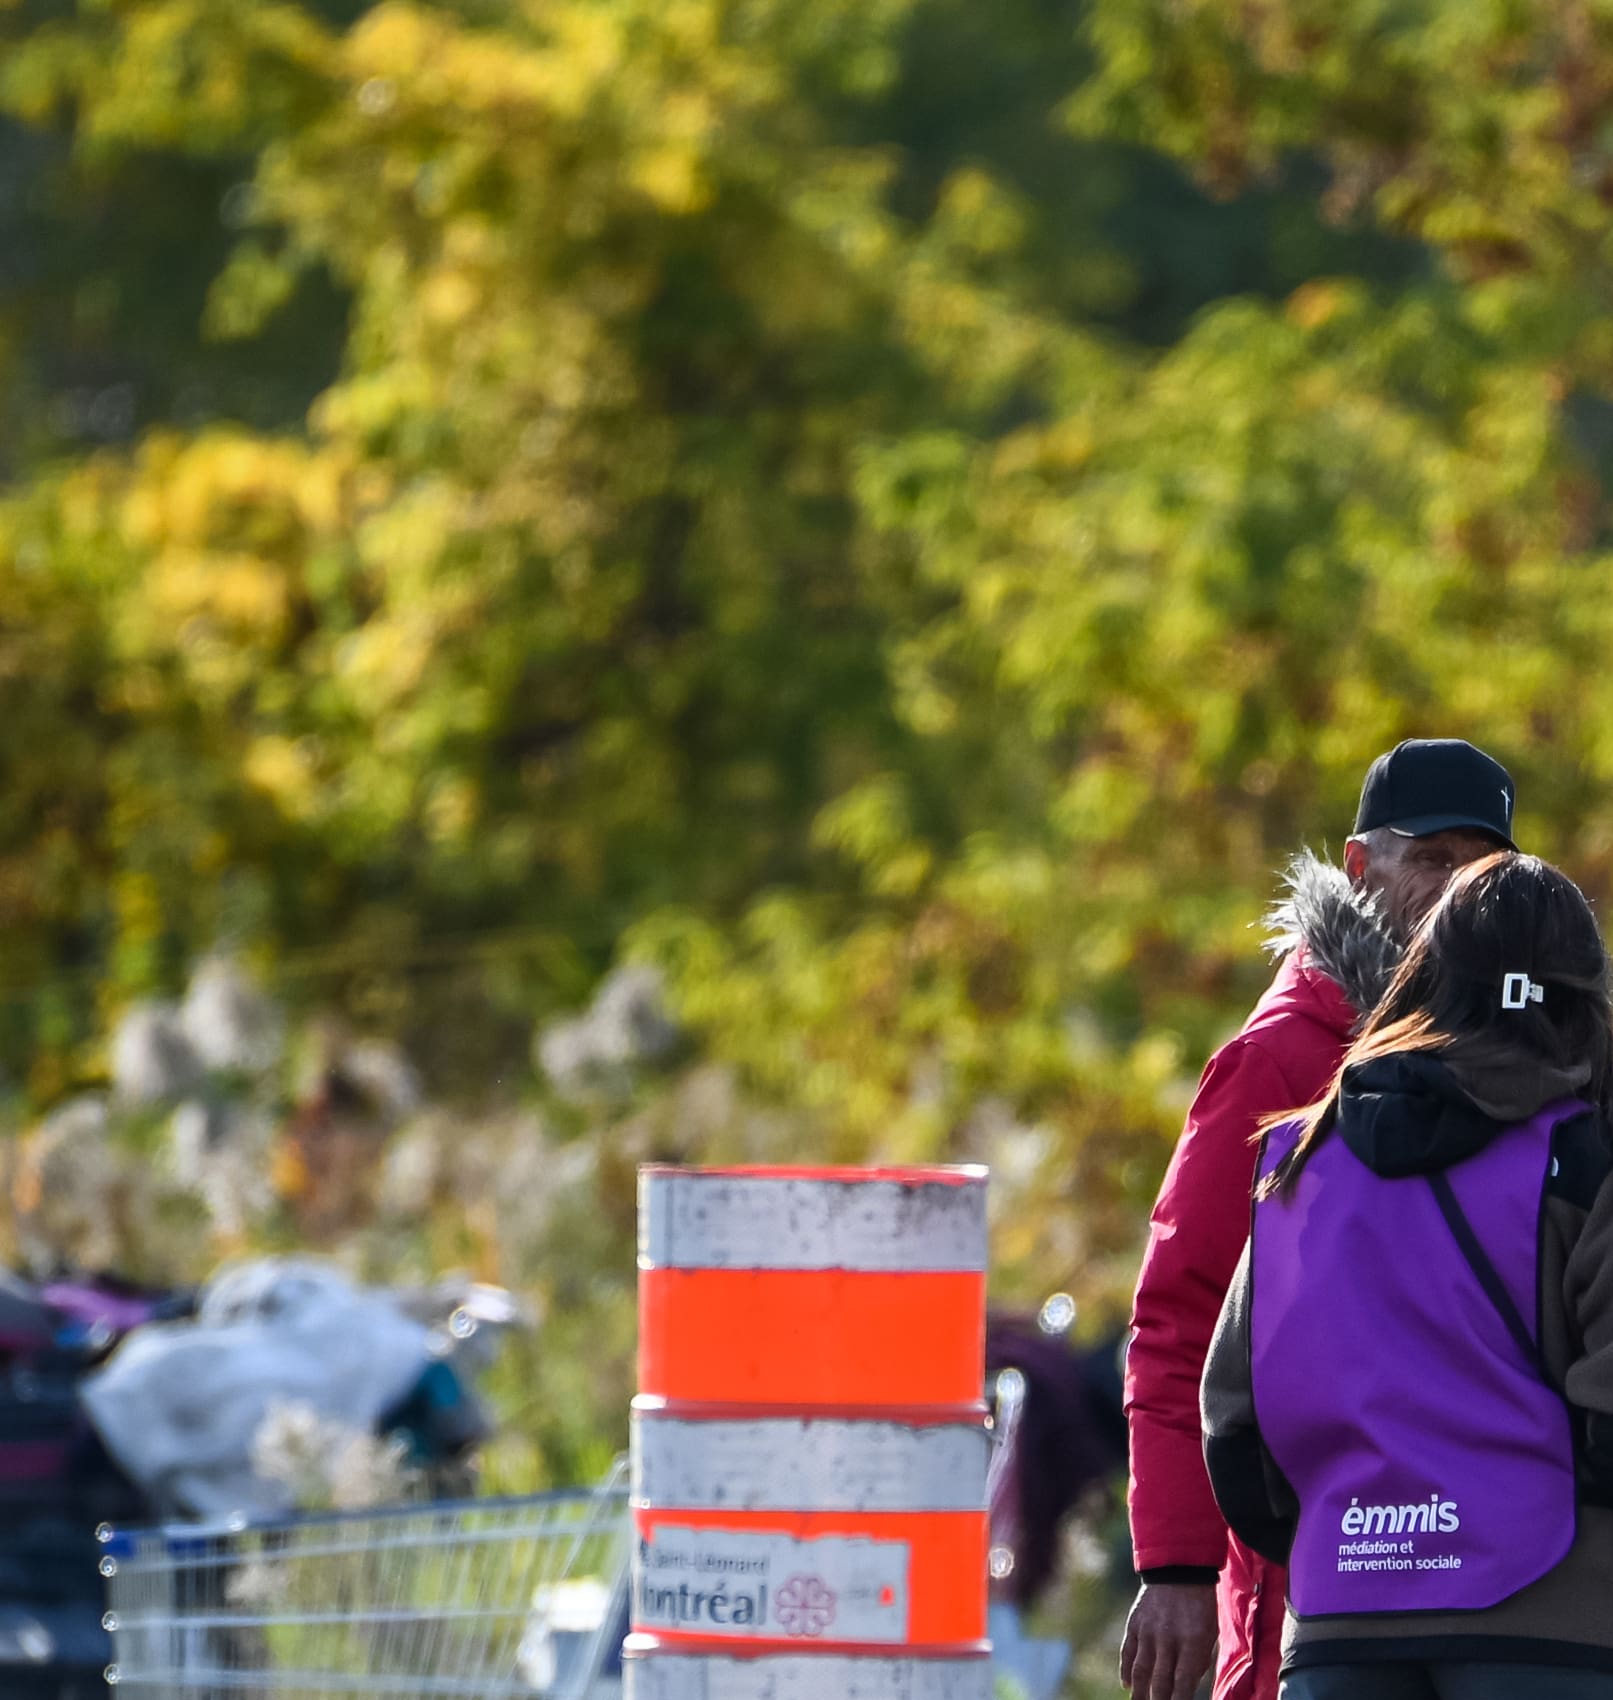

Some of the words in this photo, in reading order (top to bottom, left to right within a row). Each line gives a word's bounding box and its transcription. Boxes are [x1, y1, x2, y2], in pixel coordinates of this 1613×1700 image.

[1341, 1494, 1460, 1535] émmis
[1339, 1540, 1397, 1556] médiation
[1400, 1540, 1414, 1554] et
[1338, 1556, 1413, 1572] intervention
[1416, 1555, 1462, 1570] sociale
